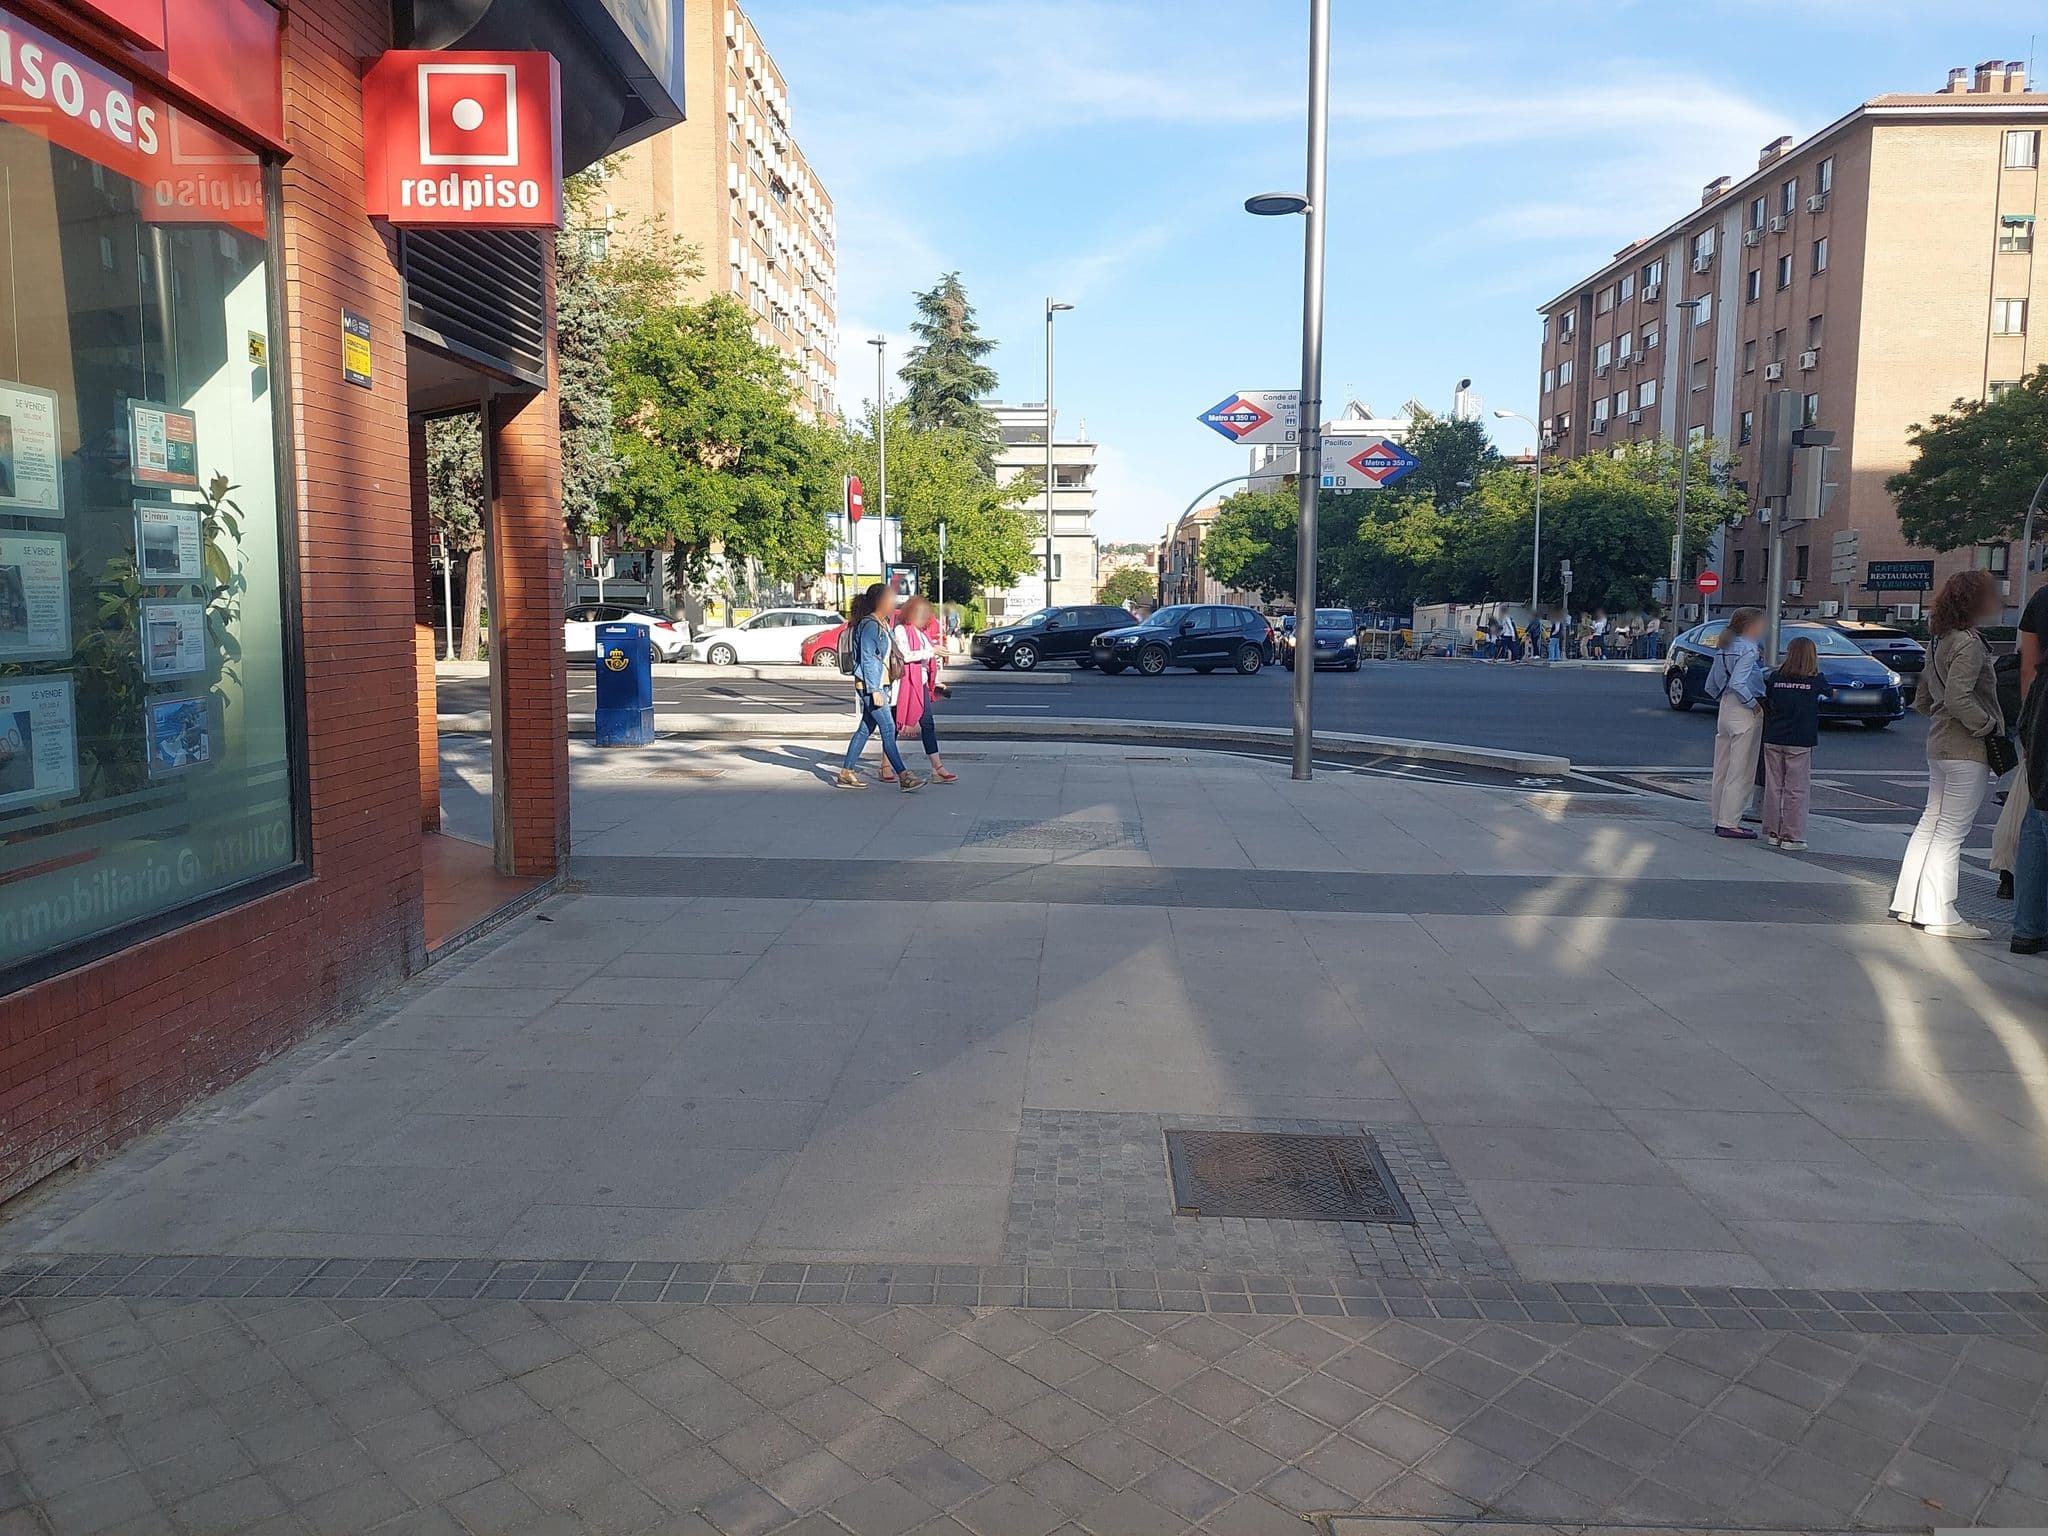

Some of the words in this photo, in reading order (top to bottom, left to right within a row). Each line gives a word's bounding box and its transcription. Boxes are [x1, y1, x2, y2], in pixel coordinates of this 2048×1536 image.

[401, 172, 539, 211] redpiso
[15, 398, 23, 408] SE
[24, 399, 47, 412] VENDE
[1208, 414, 1228, 422] Metro
[1235, 414, 1249, 422] 350
[1365, 459, 1385, 467] Metro
[1392, 459, 1406, 467] 350
[23, 546, 31, 555] SE
[32, 546, 55, 556] VENDE
[1870, 572, 1930, 580] RESTAURANTE
[1773, 682, 1812, 690] amarras
[31, 690, 40, 700] SE
[40, 688, 63, 699] VENDE
